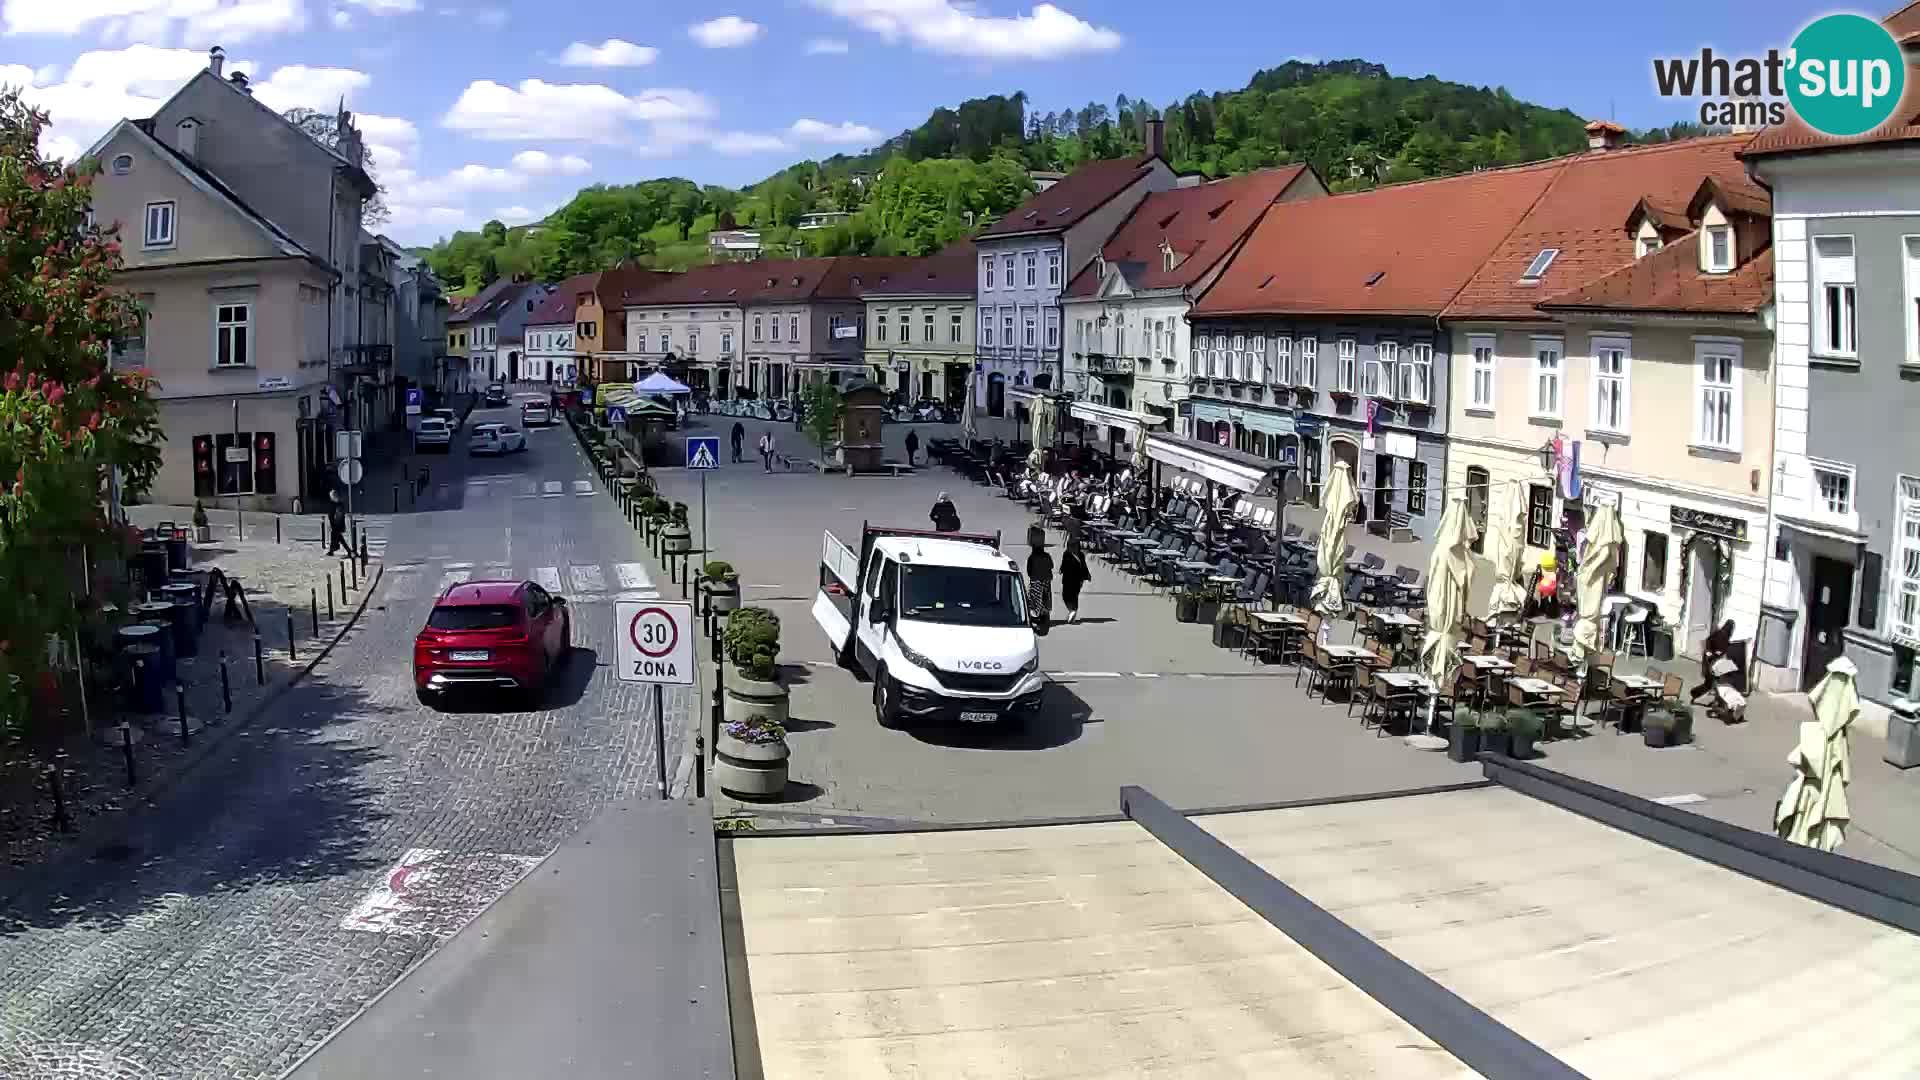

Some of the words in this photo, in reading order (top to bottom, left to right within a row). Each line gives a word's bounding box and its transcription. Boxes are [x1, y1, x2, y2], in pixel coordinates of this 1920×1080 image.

[643, 623, 667, 644] 30
[633, 660, 677, 677] ZONA
[957, 659, 1002, 669] IVECO
